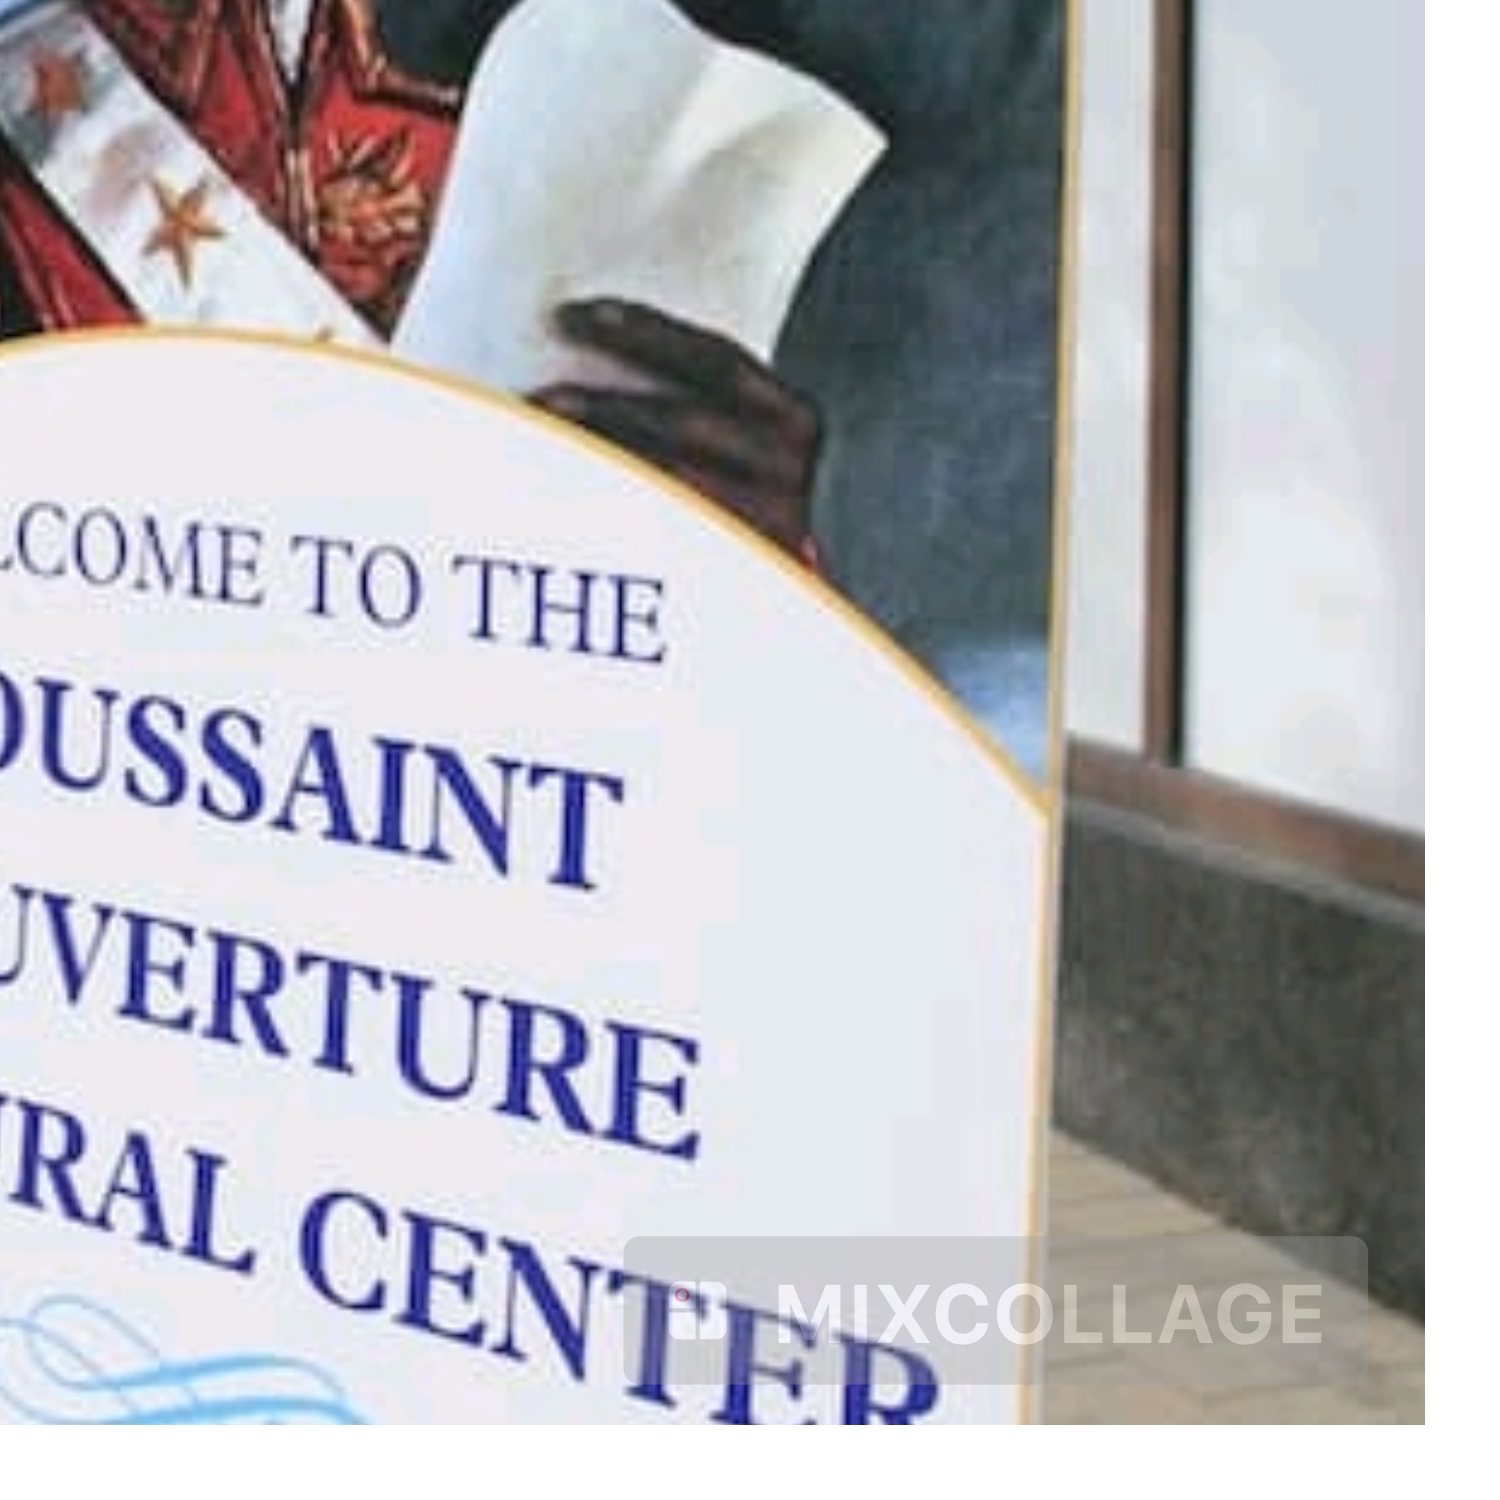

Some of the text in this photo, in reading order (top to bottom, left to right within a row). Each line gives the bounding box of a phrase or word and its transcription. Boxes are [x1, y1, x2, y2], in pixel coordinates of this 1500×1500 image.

[292, 535, 422, 629] TO
[452, 555, 666, 663] THE
[298, 1191, 943, 1425] CENTER
